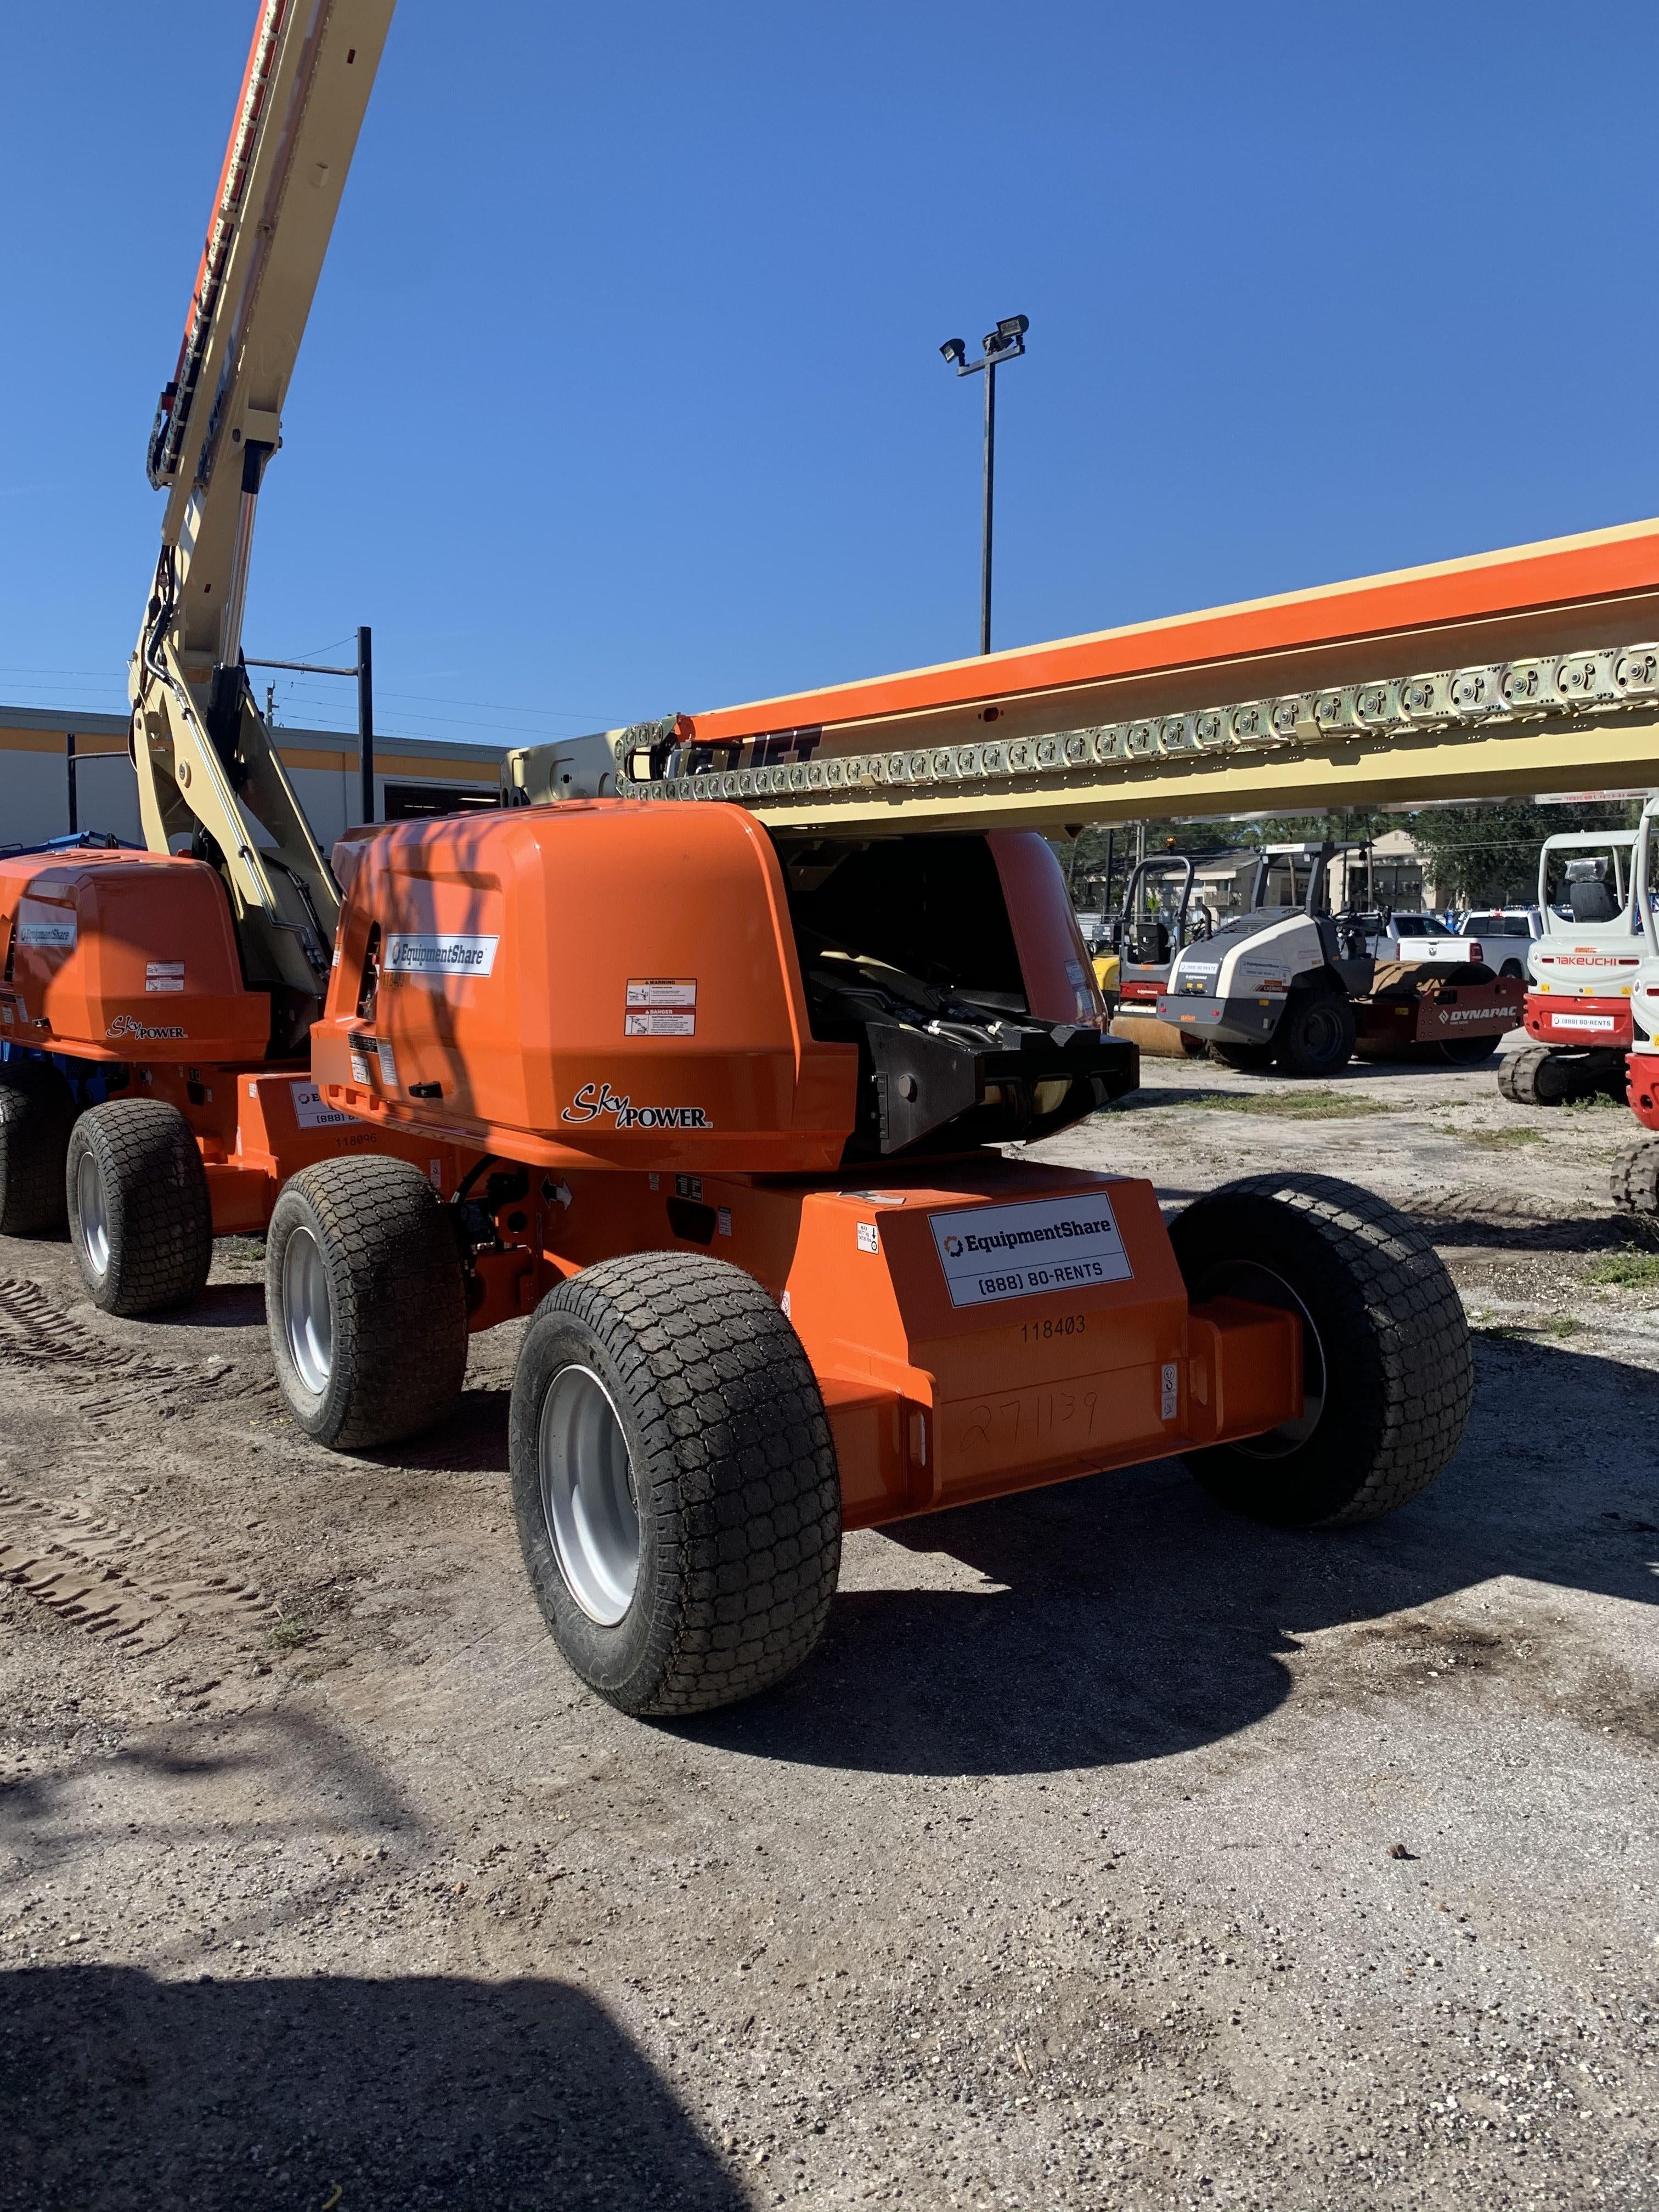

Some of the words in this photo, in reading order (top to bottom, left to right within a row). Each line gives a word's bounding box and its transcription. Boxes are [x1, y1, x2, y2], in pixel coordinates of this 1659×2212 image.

[402, 944, 484, 966] EquipmentShare
[1556, 957, 1616, 966] TAKEUCHI
[1450, 1006, 1517, 1021] DYNAPAC
[316, 1113, 345, 1124] (888)
[335, 1133, 377, 1147] 118096
[964, 1219, 1111, 1254] EquipmentShare
[978, 1273, 1024, 1296] (888)
[1027, 1262, 1104, 1287] 80-RENTS
[1020, 1314, 1086, 1342] 118403
[960, 1391, 1098, 1453] 271139
